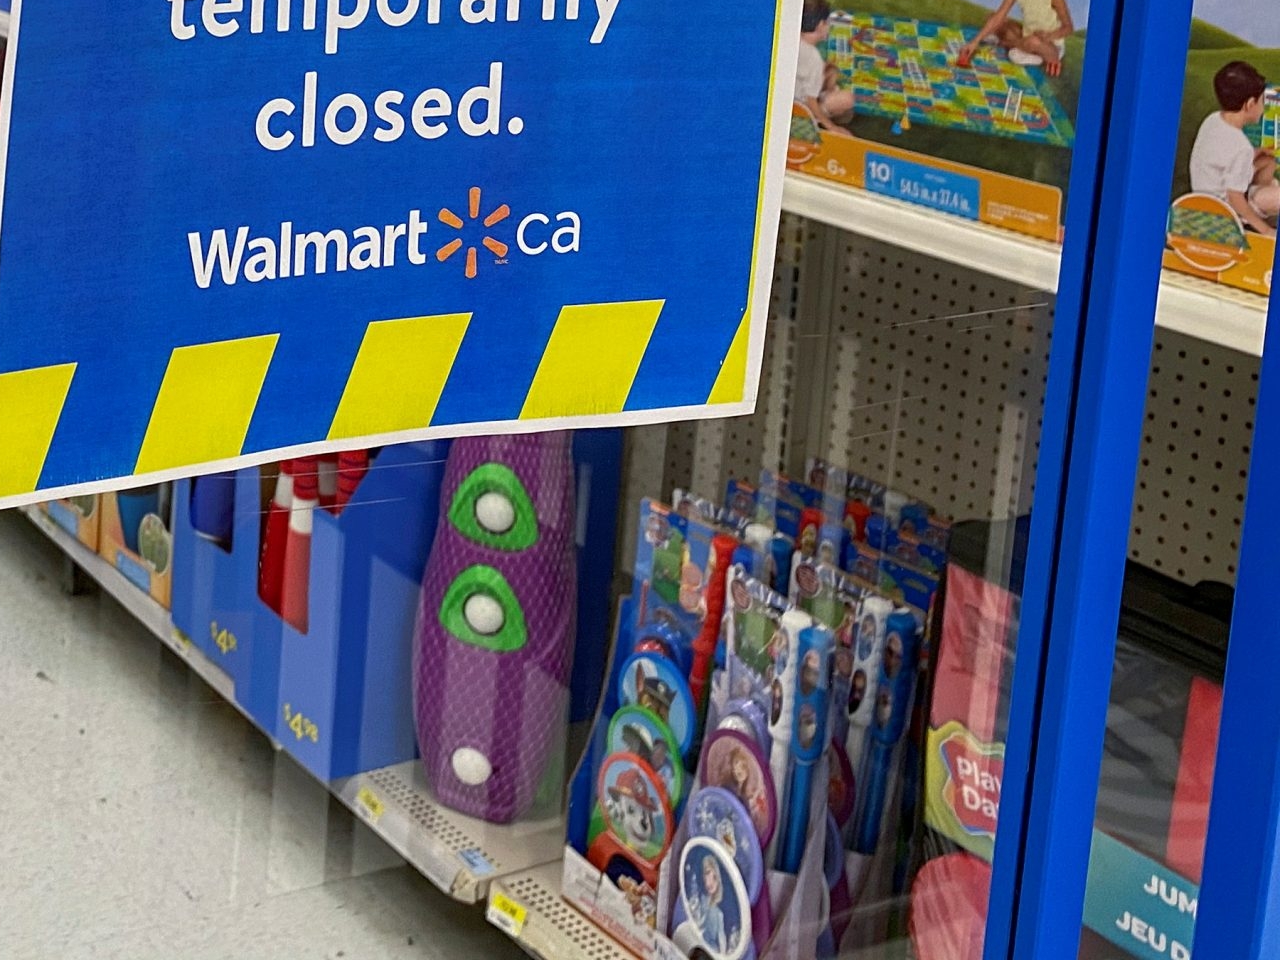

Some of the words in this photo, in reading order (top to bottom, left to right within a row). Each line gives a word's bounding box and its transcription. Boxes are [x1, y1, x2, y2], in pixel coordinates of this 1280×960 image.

[254, 61, 525, 152] closed.
[869, 160, 891, 182] 10
[187, 208, 428, 290] Walmart
[515, 210, 581, 257] ca
[962, 784, 999, 819] Da
[1116, 911, 1167, 952] JEU
